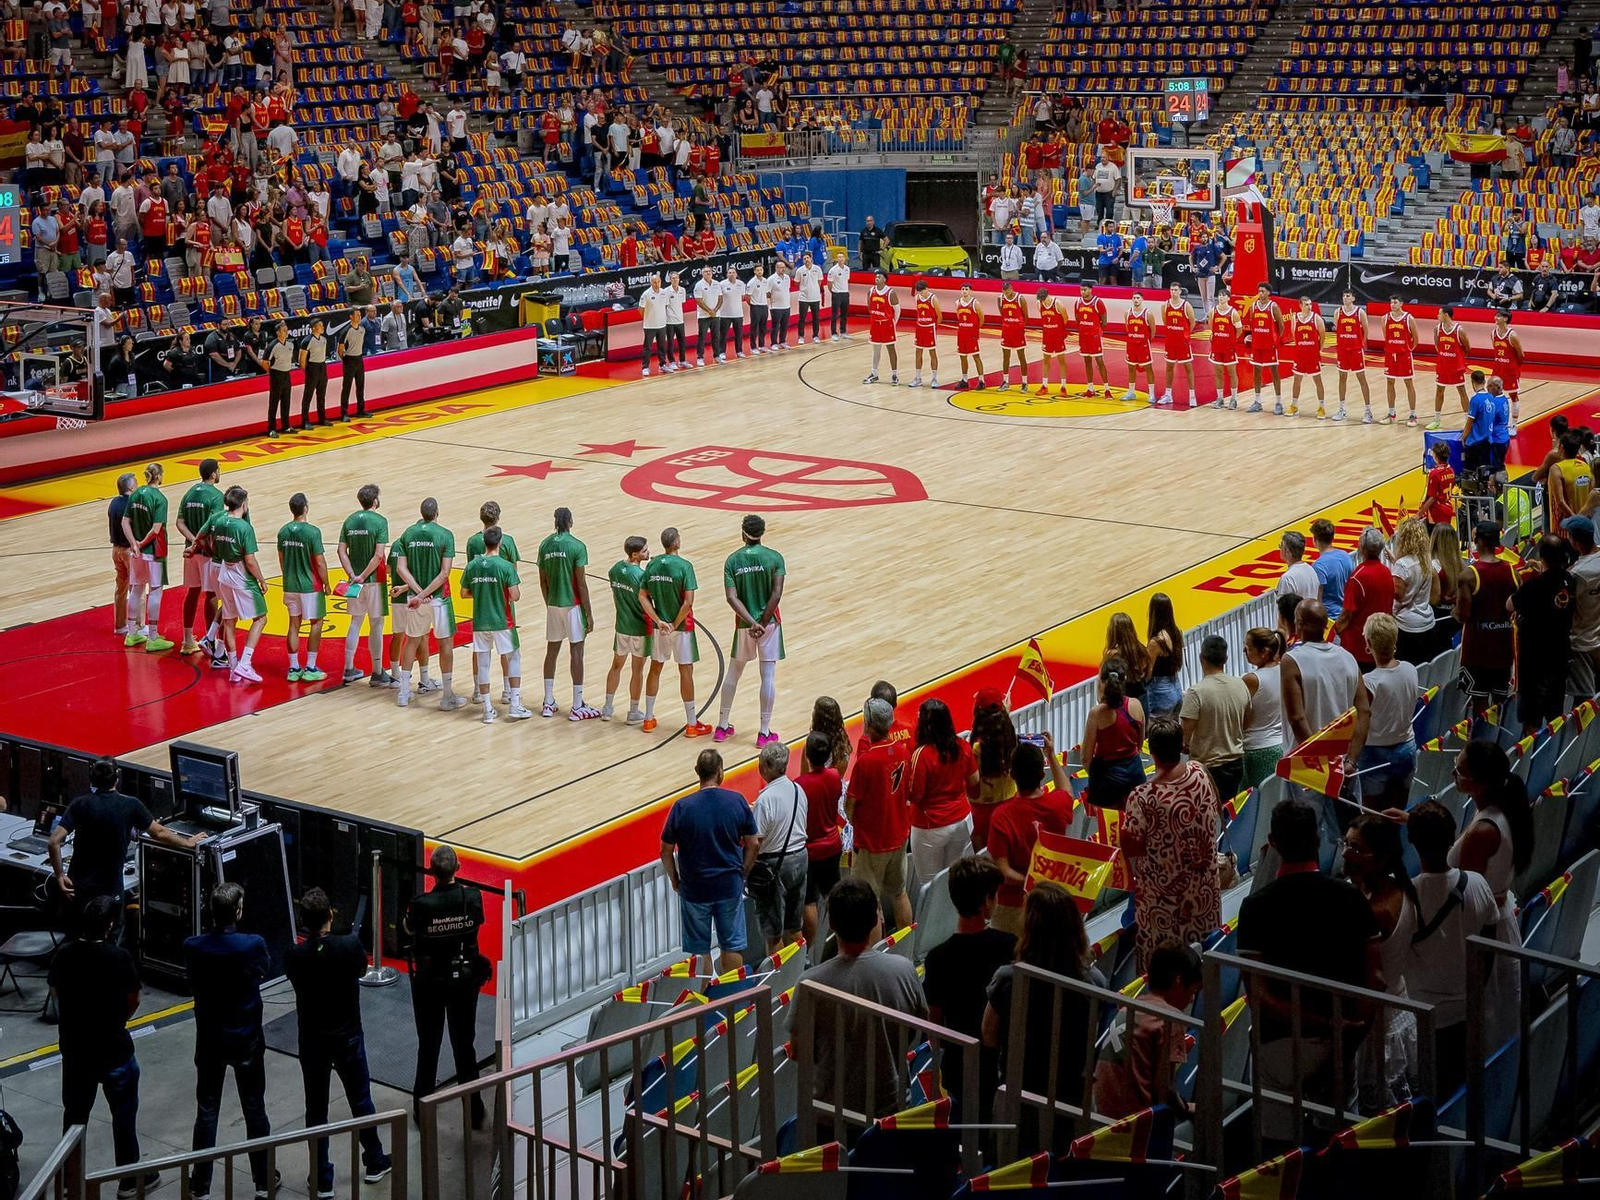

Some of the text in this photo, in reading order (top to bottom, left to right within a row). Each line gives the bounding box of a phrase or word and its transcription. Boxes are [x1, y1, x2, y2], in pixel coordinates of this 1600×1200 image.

[1169, 82, 1190, 90] 5:08
[1168, 94, 1190, 112] 24
[1196, 93, 1207, 110] 24
[691, 265, 723, 278] ensa
[1402, 274, 1452, 288] endesa
[176, 403, 495, 463] MÁLAGA
[665, 450, 734, 466] FEB
[1033, 852, 1089, 892] ESPAÑA
[428, 920, 474, 933] SEGURIDAD
